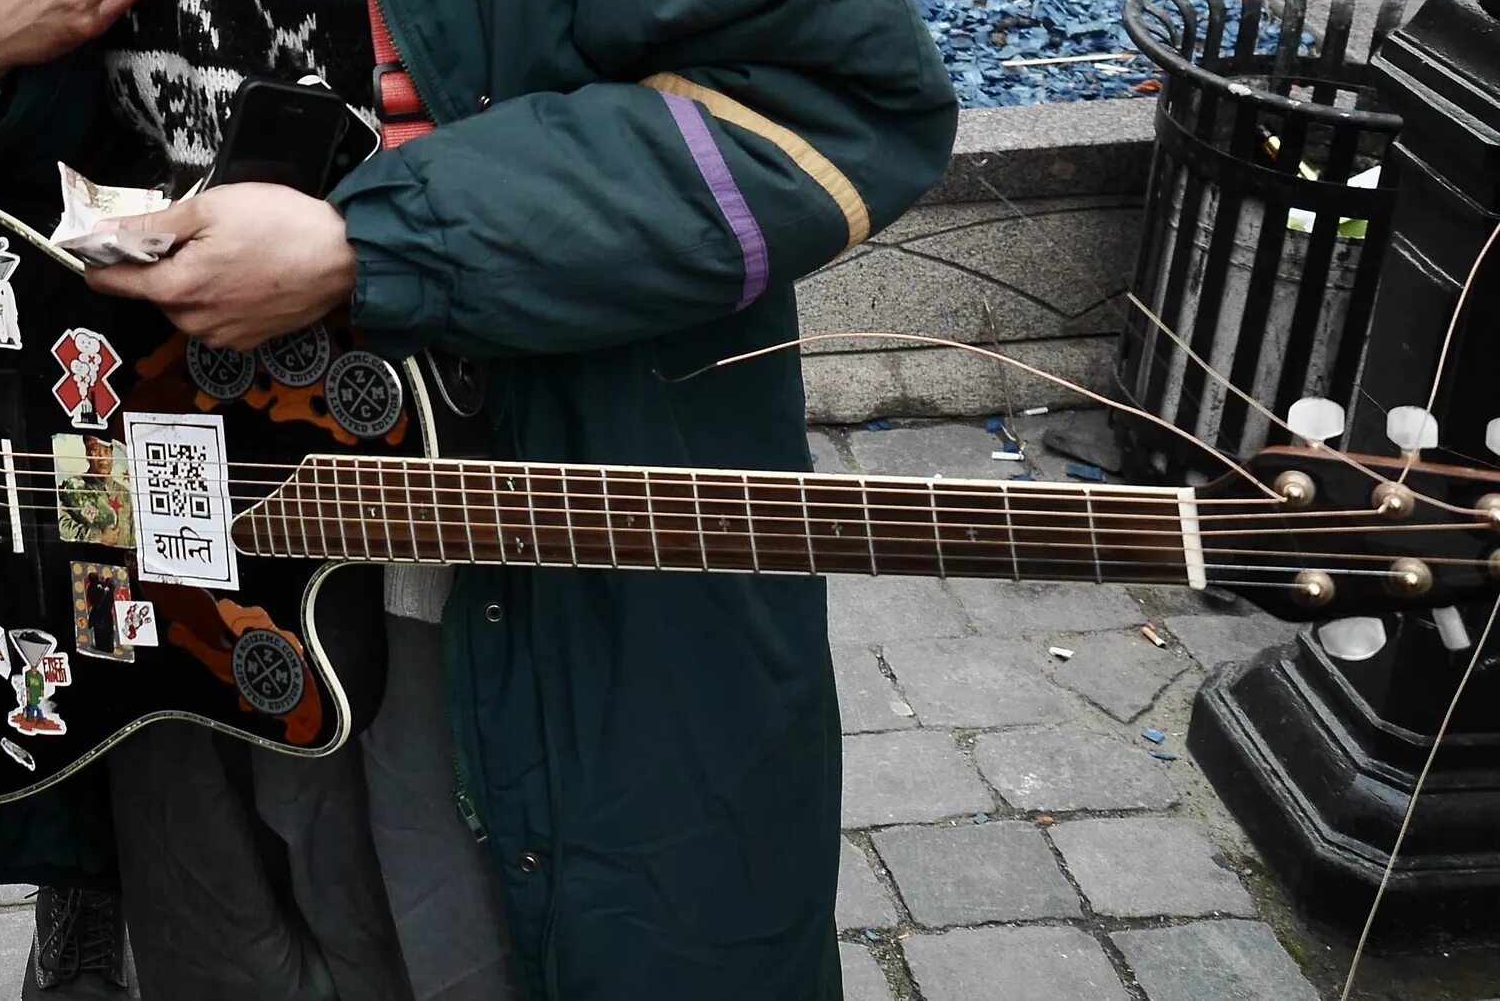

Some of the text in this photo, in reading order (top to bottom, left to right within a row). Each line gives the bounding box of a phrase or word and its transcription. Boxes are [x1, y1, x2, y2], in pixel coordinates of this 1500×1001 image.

[153, 526, 213, 563] शान्ति
[236, 663, 299, 709] LIMITED EDITION
